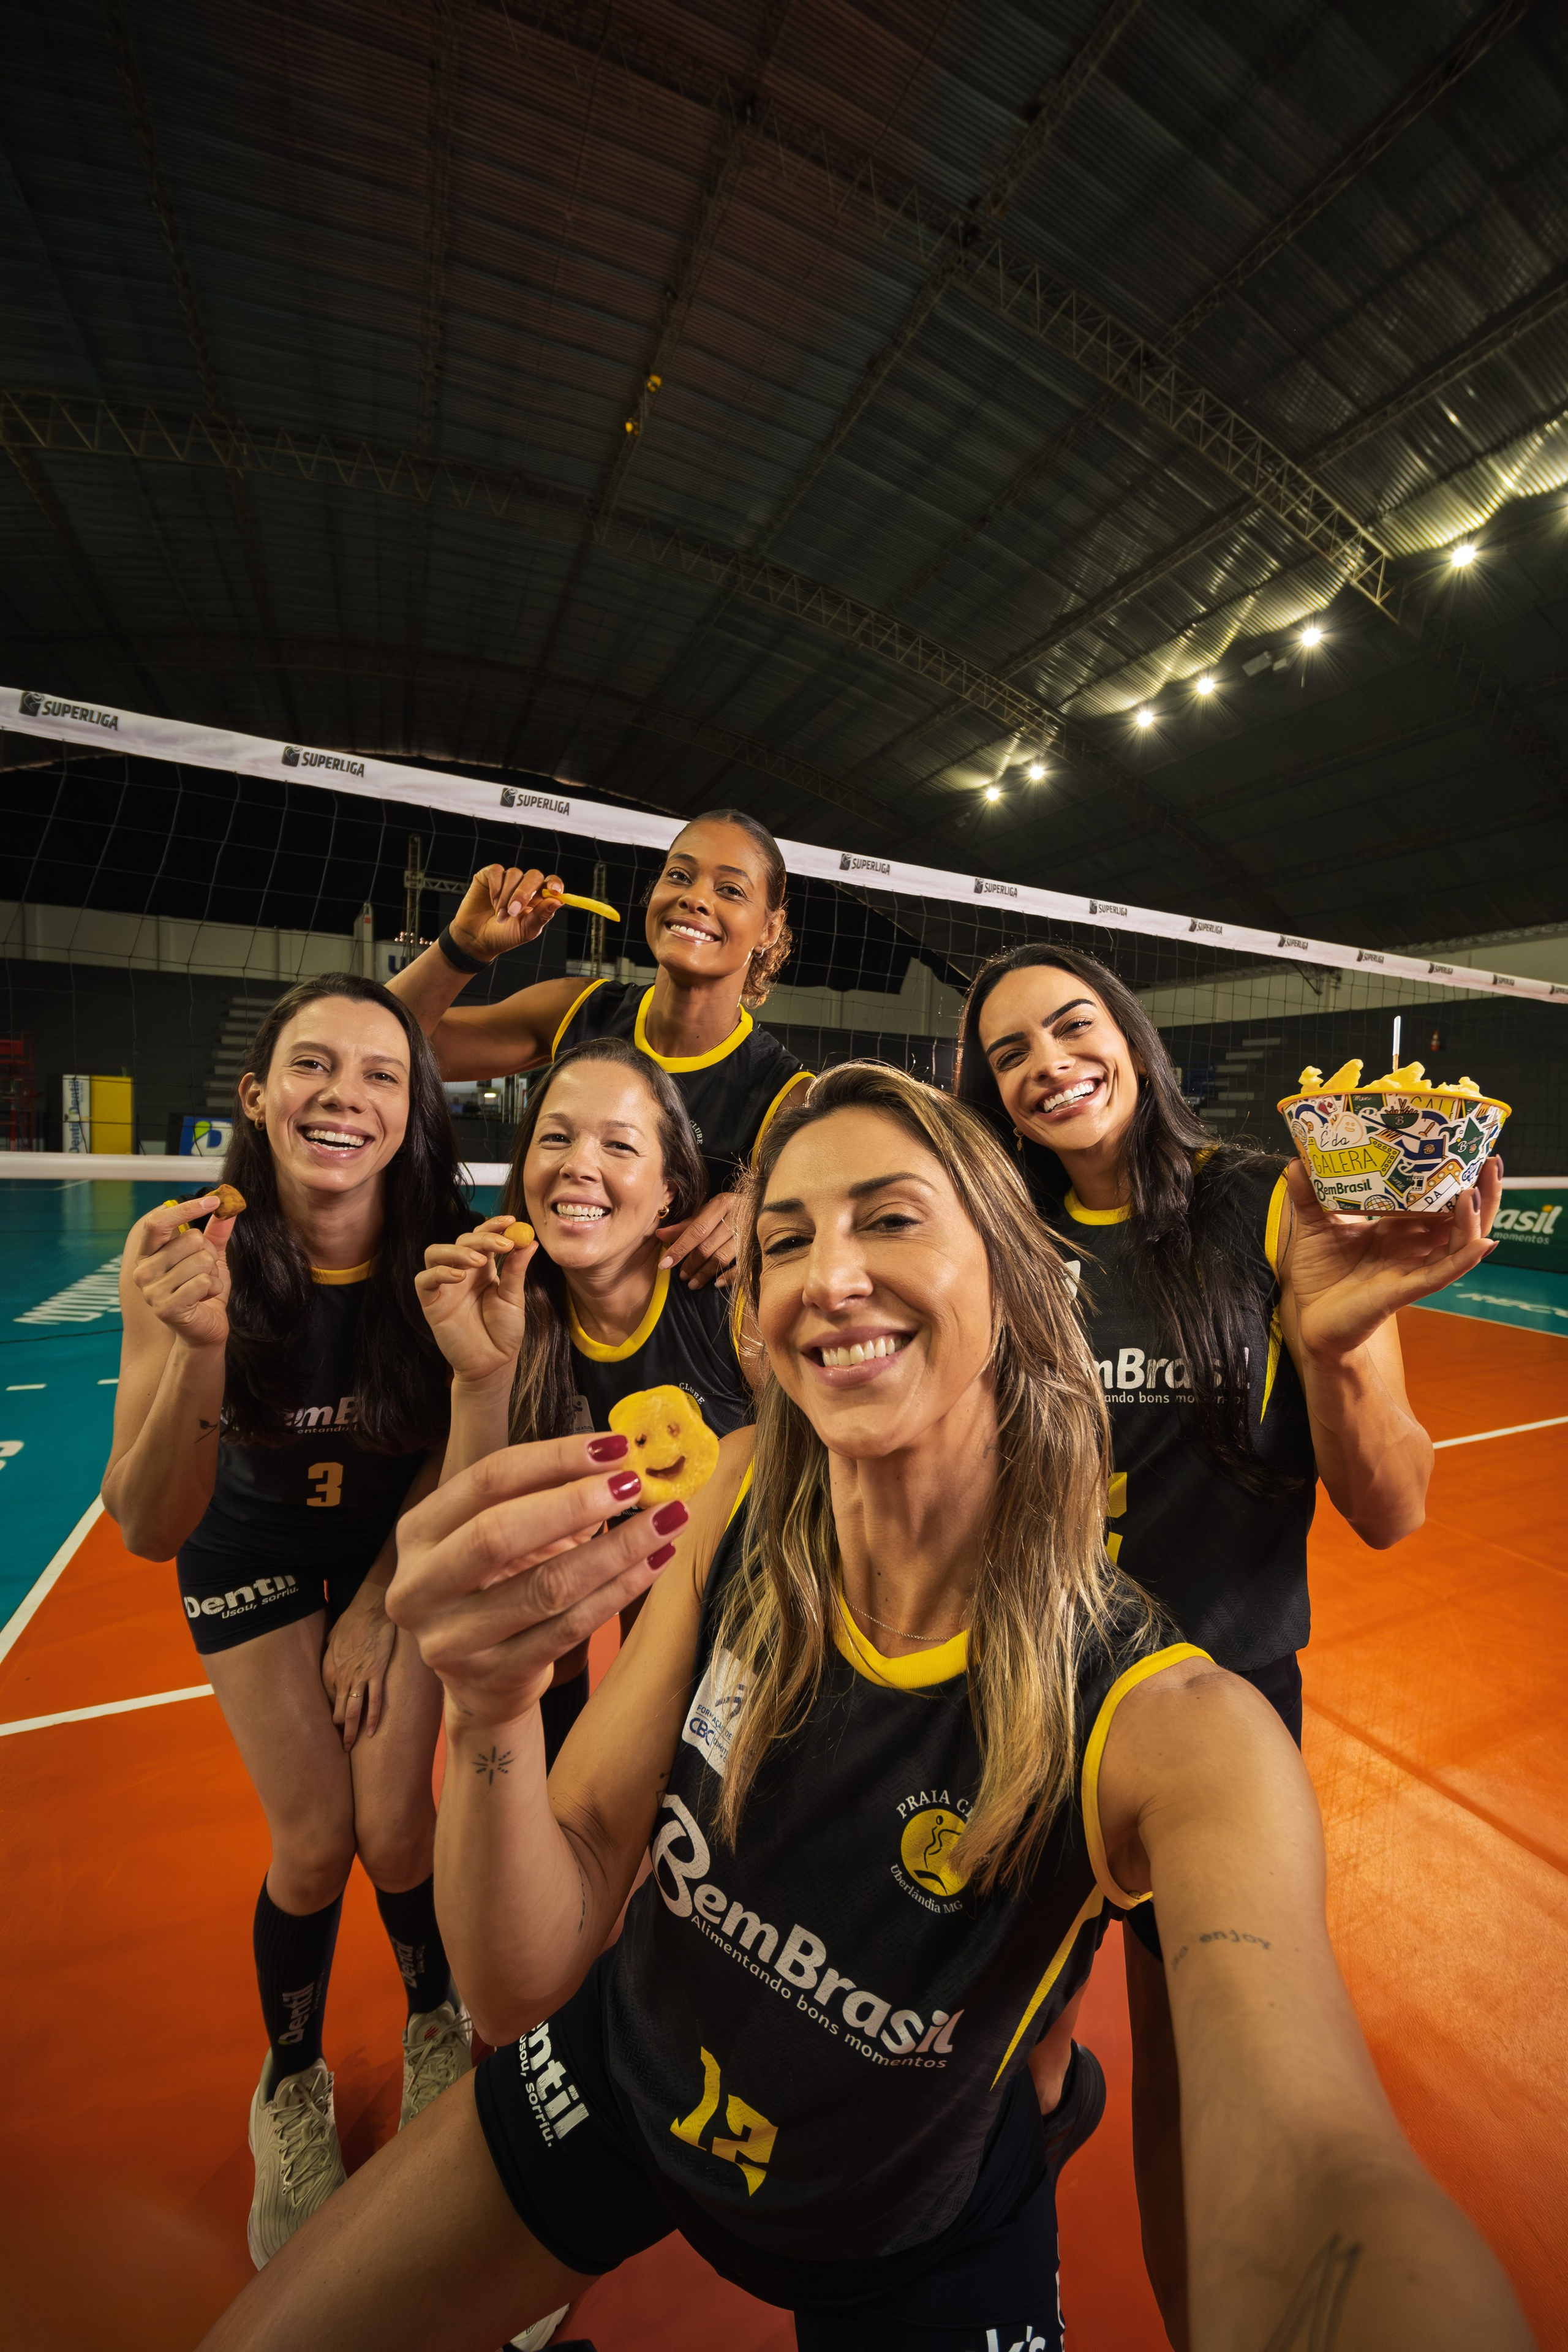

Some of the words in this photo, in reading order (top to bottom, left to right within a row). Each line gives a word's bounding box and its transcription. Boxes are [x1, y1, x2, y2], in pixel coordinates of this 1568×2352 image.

[42, 701, 118, 731] SUPERLIGA
[301, 752, 365, 778] SUPERLIGA
[516, 794, 570, 816] SUPERLIGA
[851, 858, 890, 876] SUPERLIGA
[984, 882, 1017, 898] SUPERLIGA
[1099, 904, 1128, 918] SUPERLIGA
[1197, 922, 1223, 935] SUPERLIGA
[1286, 938, 1309, 950] SUPERLIGA
[688, 1120, 703, 1144] CLUBE
[1313, 1148, 1378, 1174] GALERA
[1314, 1178, 1373, 1202] BemBrasil
[1424, 1191, 1442, 1205] DA
[1493, 1232, 1550, 1245] momentos
[679, 1382, 705, 1404] CLUBE
[1139, 1392, 1170, 1403] bons
[306, 1462, 344, 1507] 3
[184, 1574, 297, 1619] Dentil
[689, 1717, 714, 1747] CBC
[896, 1790, 951, 1820] PRAIA
[890, 1864, 941, 1914] Uberlândia
[943, 1900, 963, 1913] MG
[651, 1794, 965, 2054] BemBrasil
[691, 1915, 792, 1999] Alimentando
[797, 1994, 839, 2035] bons
[845, 2032, 947, 2069] momentos
[525, 2082, 554, 2147] sorriu.
